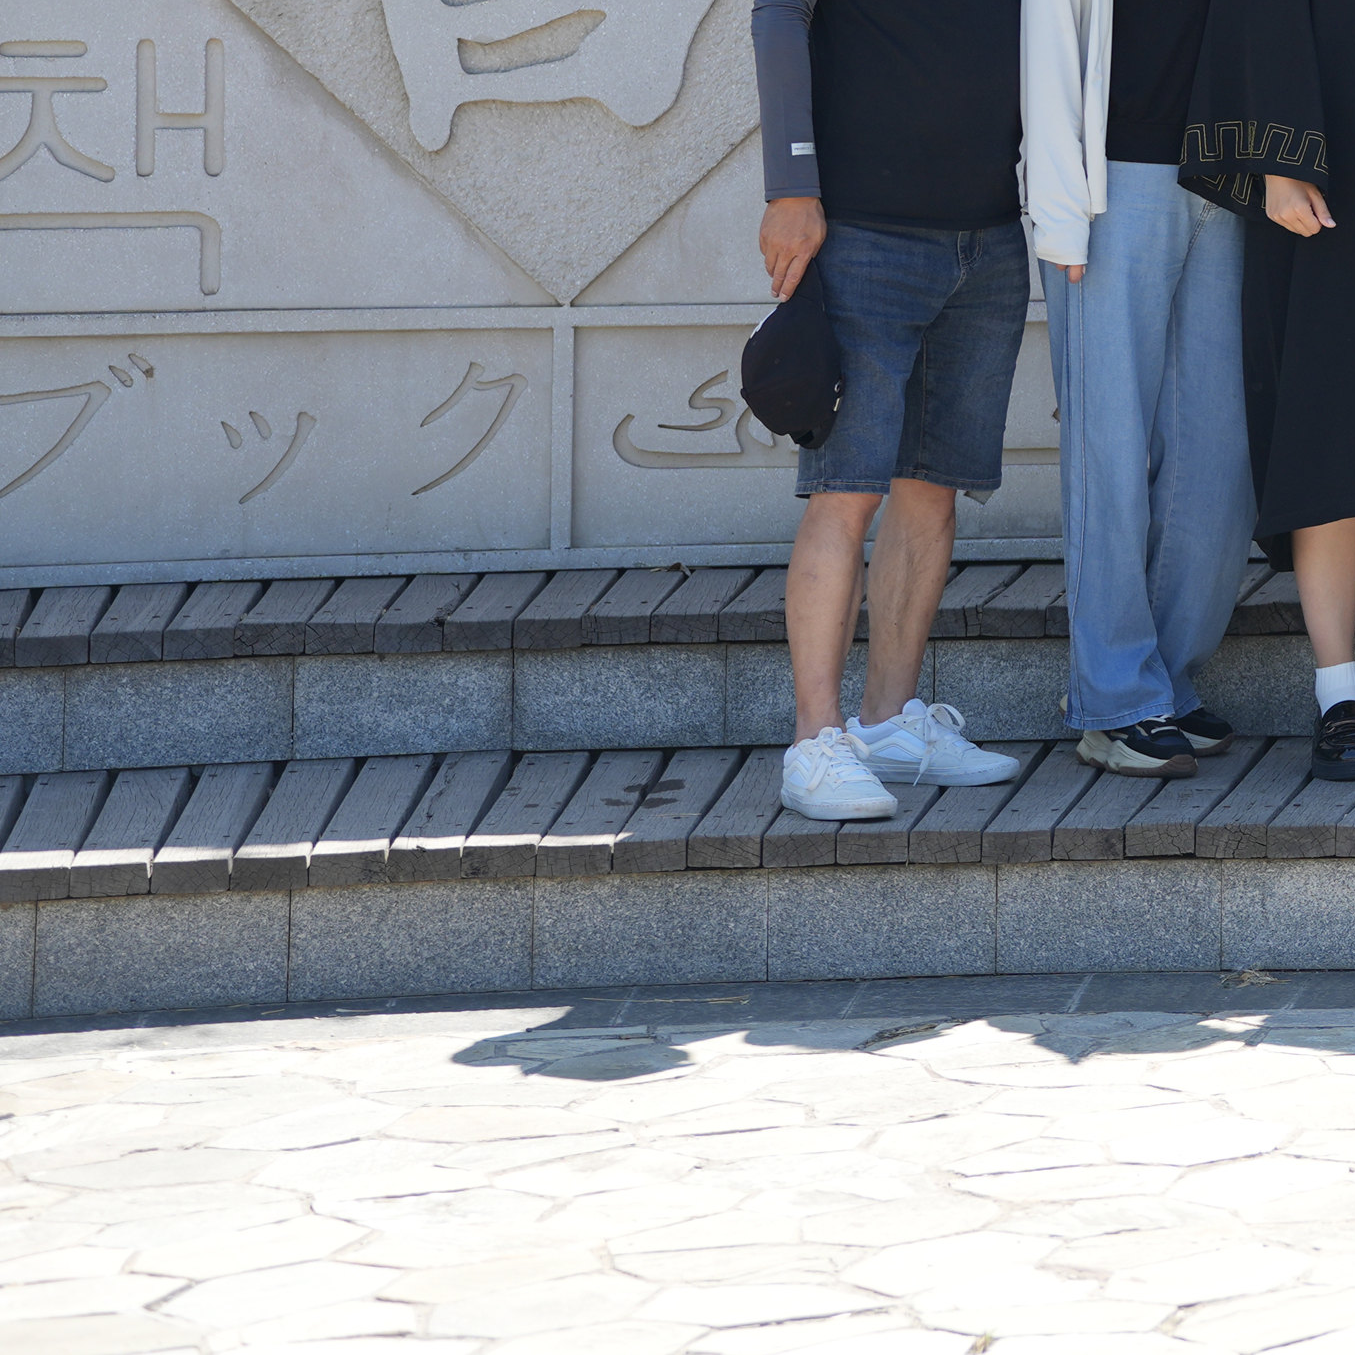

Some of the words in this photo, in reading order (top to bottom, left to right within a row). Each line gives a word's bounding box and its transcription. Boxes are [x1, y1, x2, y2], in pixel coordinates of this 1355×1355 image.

[0, 38, 225, 295] 책
[0, 352, 528, 505] ブック
